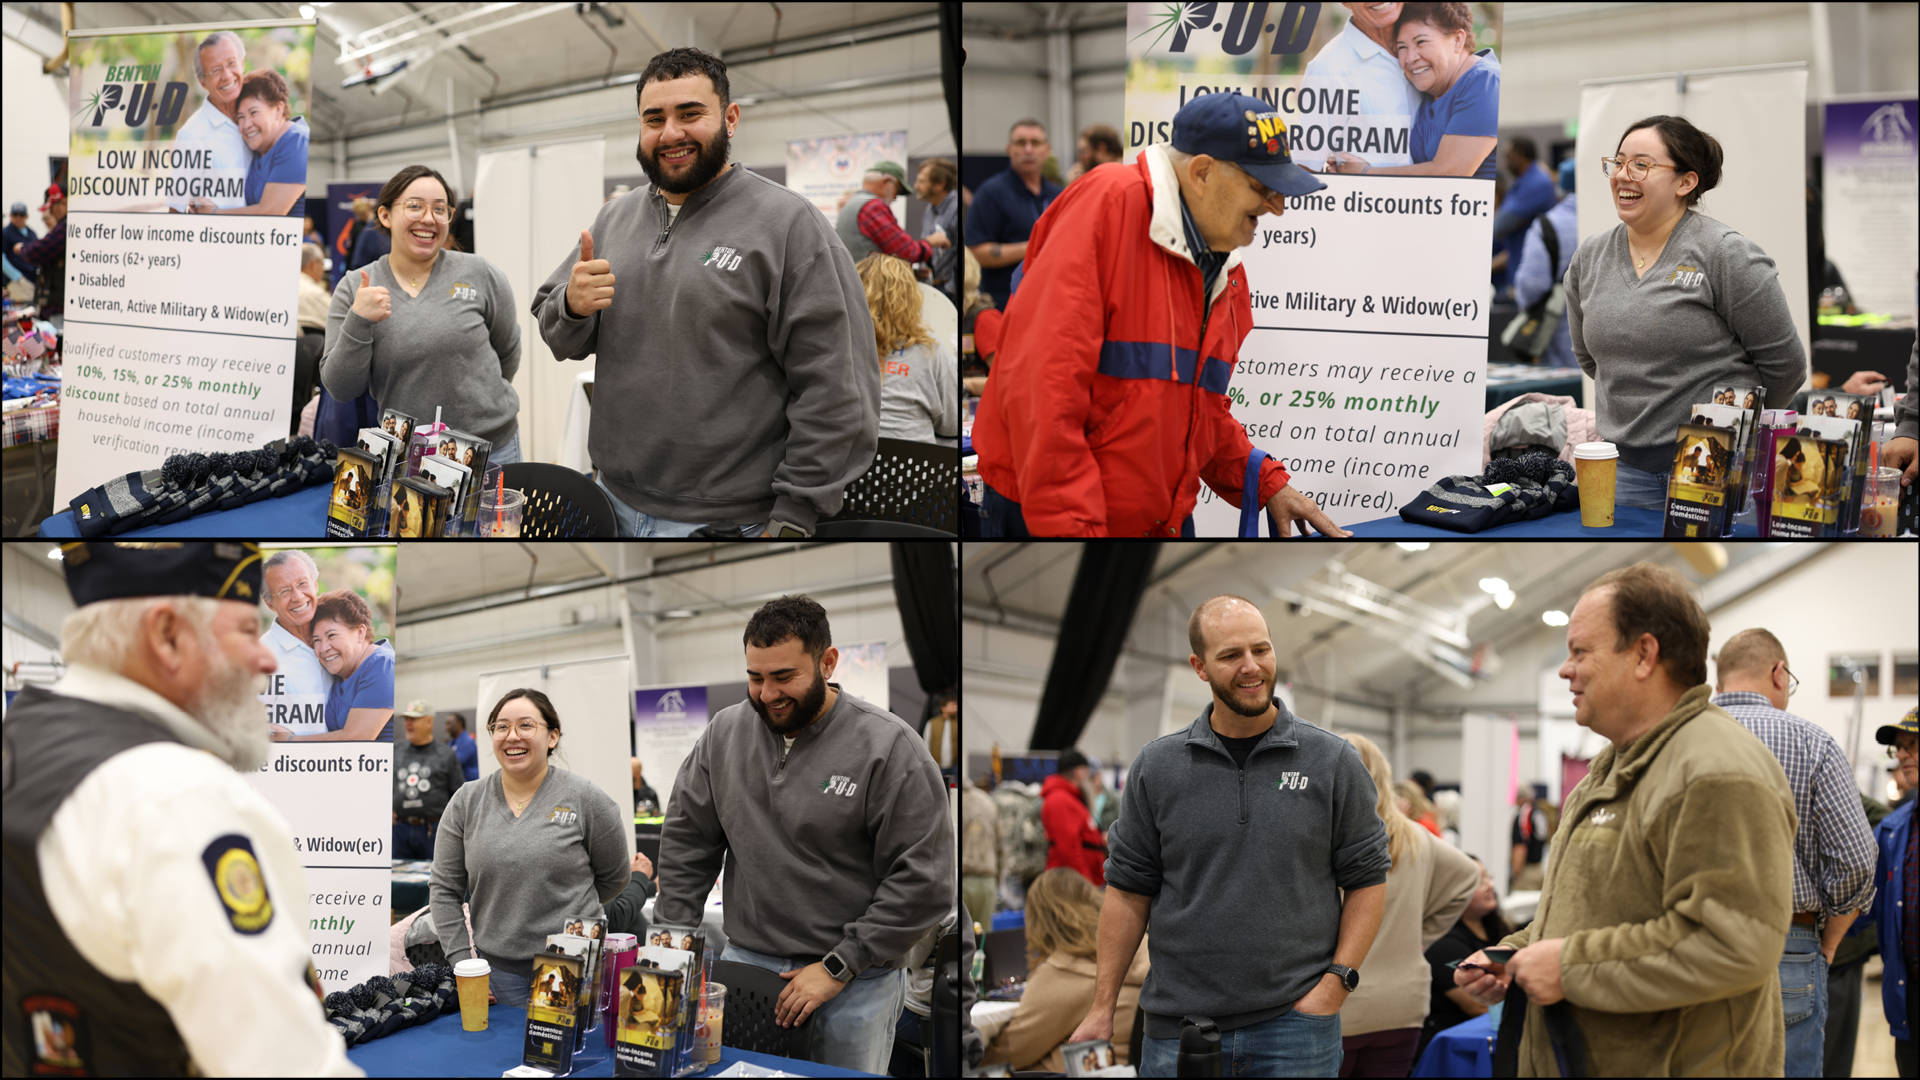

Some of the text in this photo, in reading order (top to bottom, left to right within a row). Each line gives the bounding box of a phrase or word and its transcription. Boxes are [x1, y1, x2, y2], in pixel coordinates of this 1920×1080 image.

[105, 64, 162, 82] BENTON
[1256, 117, 1288, 144] NA
[1290, 124, 1409, 154] ROGRAM
[97, 150, 213, 169] LOW INCOME
[70, 177, 244, 198] DISCOUNT PROGRAM
[1283, 191, 1488, 217] come discounts for:
[68, 223, 298, 247] We offer low income discounts for:
[1262, 227, 1317, 248] years)
[80, 250, 181, 270] Seniors (62+ years)
[79, 273, 125, 289] Disabled
[78, 296, 289, 326] Veteran, Active Military & Widow(er)
[1250, 290, 1479, 320] tive Military & Widow(er)
[64, 340, 286, 375] Qualified customers may receive a
[77, 365, 261, 400] 10%, 15%, or 25% monthly
[1237, 359, 1477, 384] stomers may receive a
[65, 385, 275, 421] discount based on total annual
[1260, 392, 1283, 406] or
[1288, 390, 1336, 409] 25%
[1344, 393, 1440, 419] monthly
[78, 408, 255, 444] household income (income
[1290, 425, 1317, 440] on
[1325, 425, 1376, 444] total
[1383, 429, 1460, 448] annual
[93, 434, 160, 455] verification
[1343, 456, 1430, 478] (income
[1299, 489, 1399, 513] equired).
[265, 703, 324, 724] GRAM
[274, 755, 352, 773] discounts
[358, 754, 388, 772] for:
[307, 837, 383, 855] Widow(er)
[308, 891, 382, 906] receive a
[309, 915, 355, 935] nthly
[312, 941, 371, 956] annual
[314, 968, 349, 981] ome
